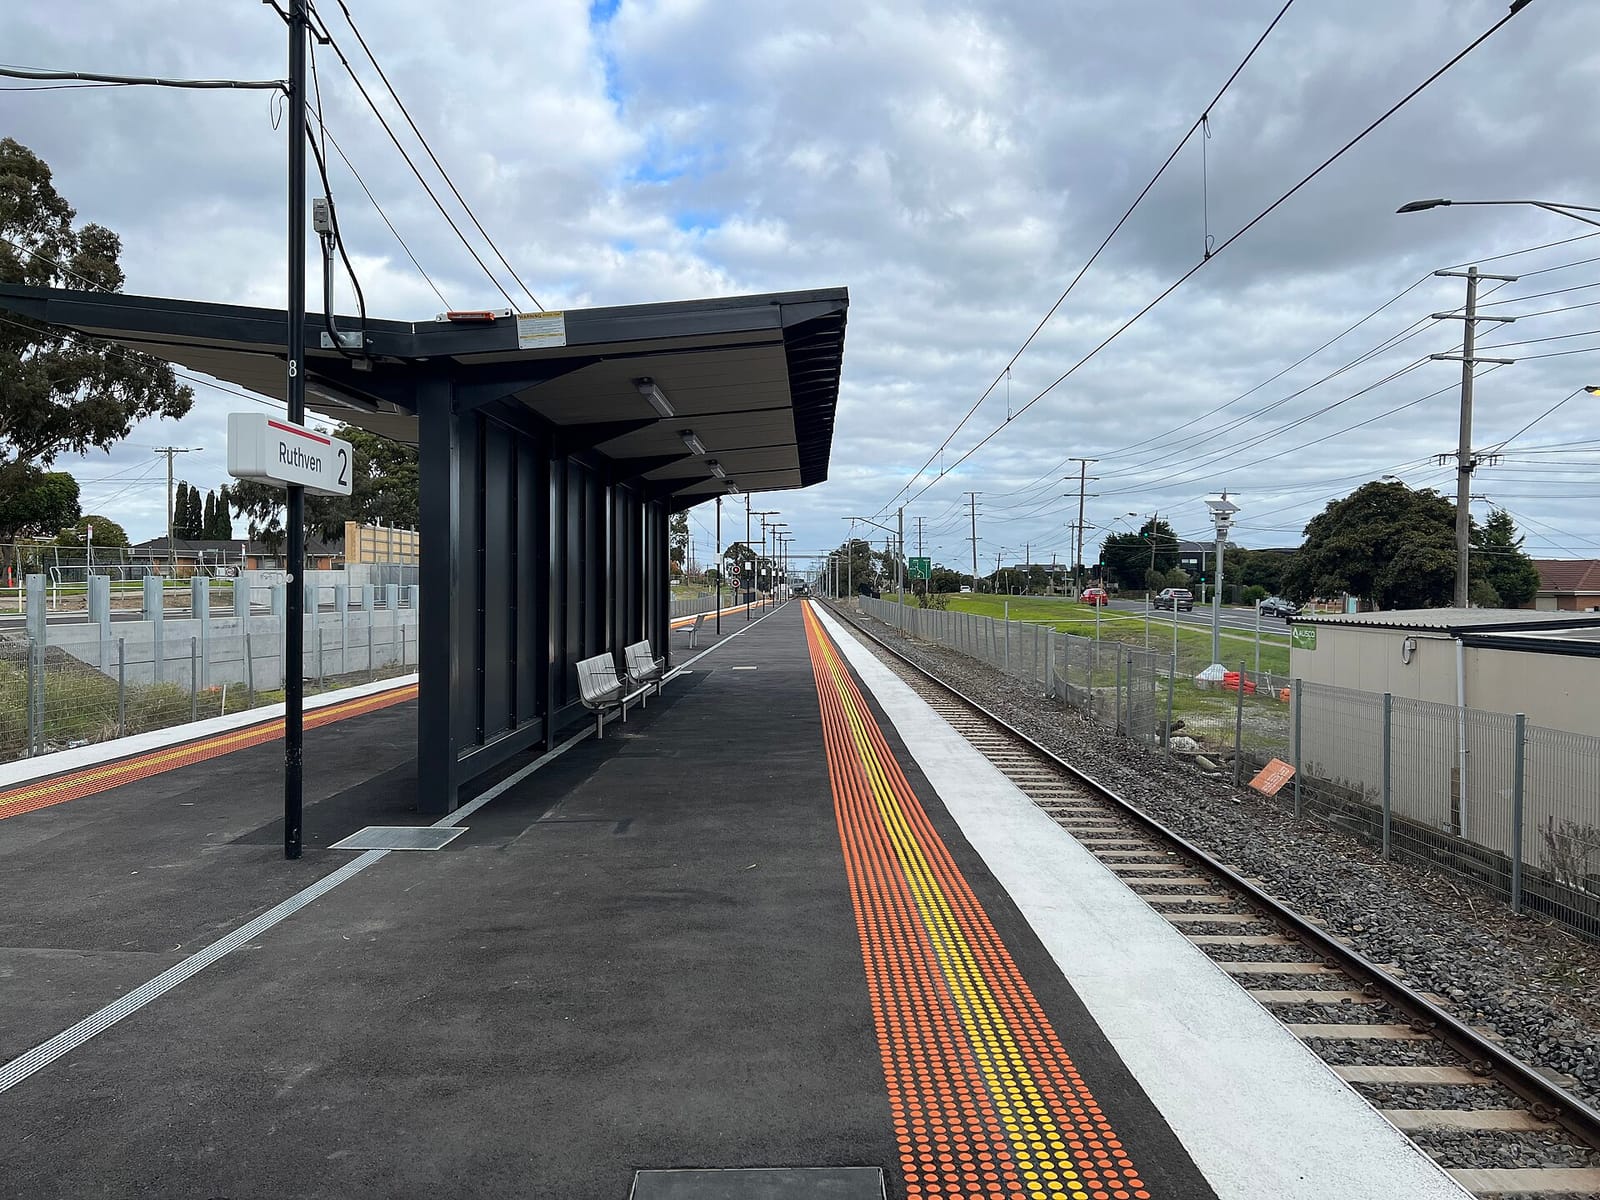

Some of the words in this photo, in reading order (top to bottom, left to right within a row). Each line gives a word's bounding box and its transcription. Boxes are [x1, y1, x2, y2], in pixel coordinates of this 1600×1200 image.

[289, 359, 297, 377] 8
[279, 441, 322, 473] Ruthven
[337, 448, 348, 487] 2
